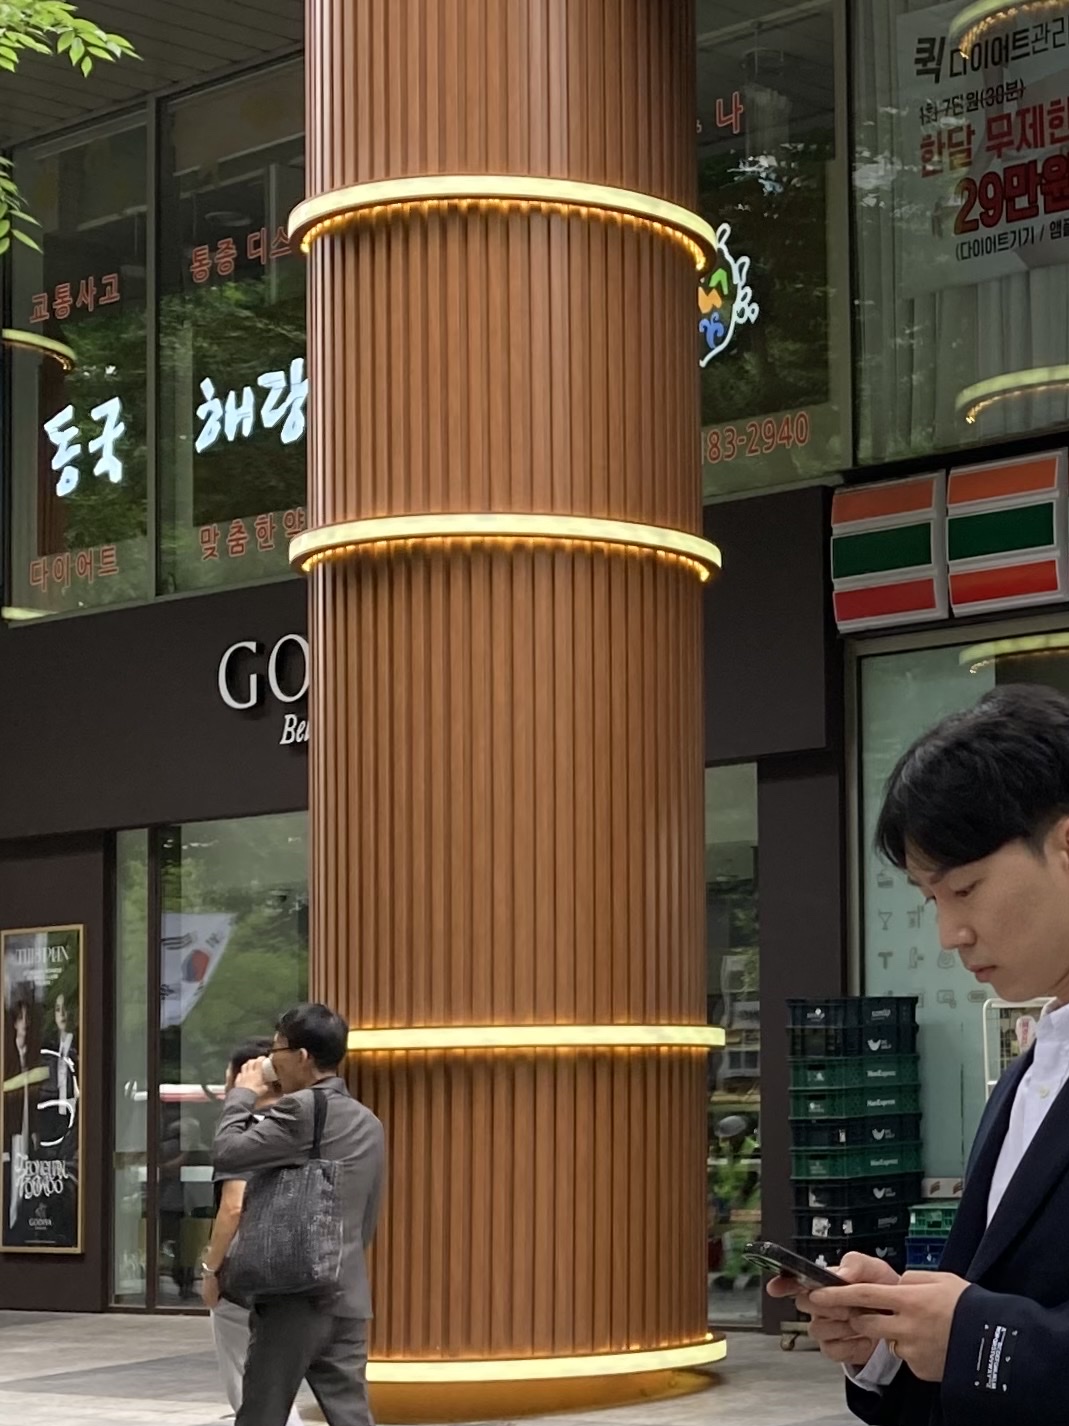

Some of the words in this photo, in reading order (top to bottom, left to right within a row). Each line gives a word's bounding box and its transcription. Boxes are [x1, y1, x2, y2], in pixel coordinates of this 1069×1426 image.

[914, 36, 946, 84] 퀵
[920, 123, 975, 178] 한달
[29, 273, 121, 323] 교통사고
[44, 396, 125, 497] 동국
[701, 411, 809, 465] 83-2940
[29, 544, 119, 592] 다이어트
